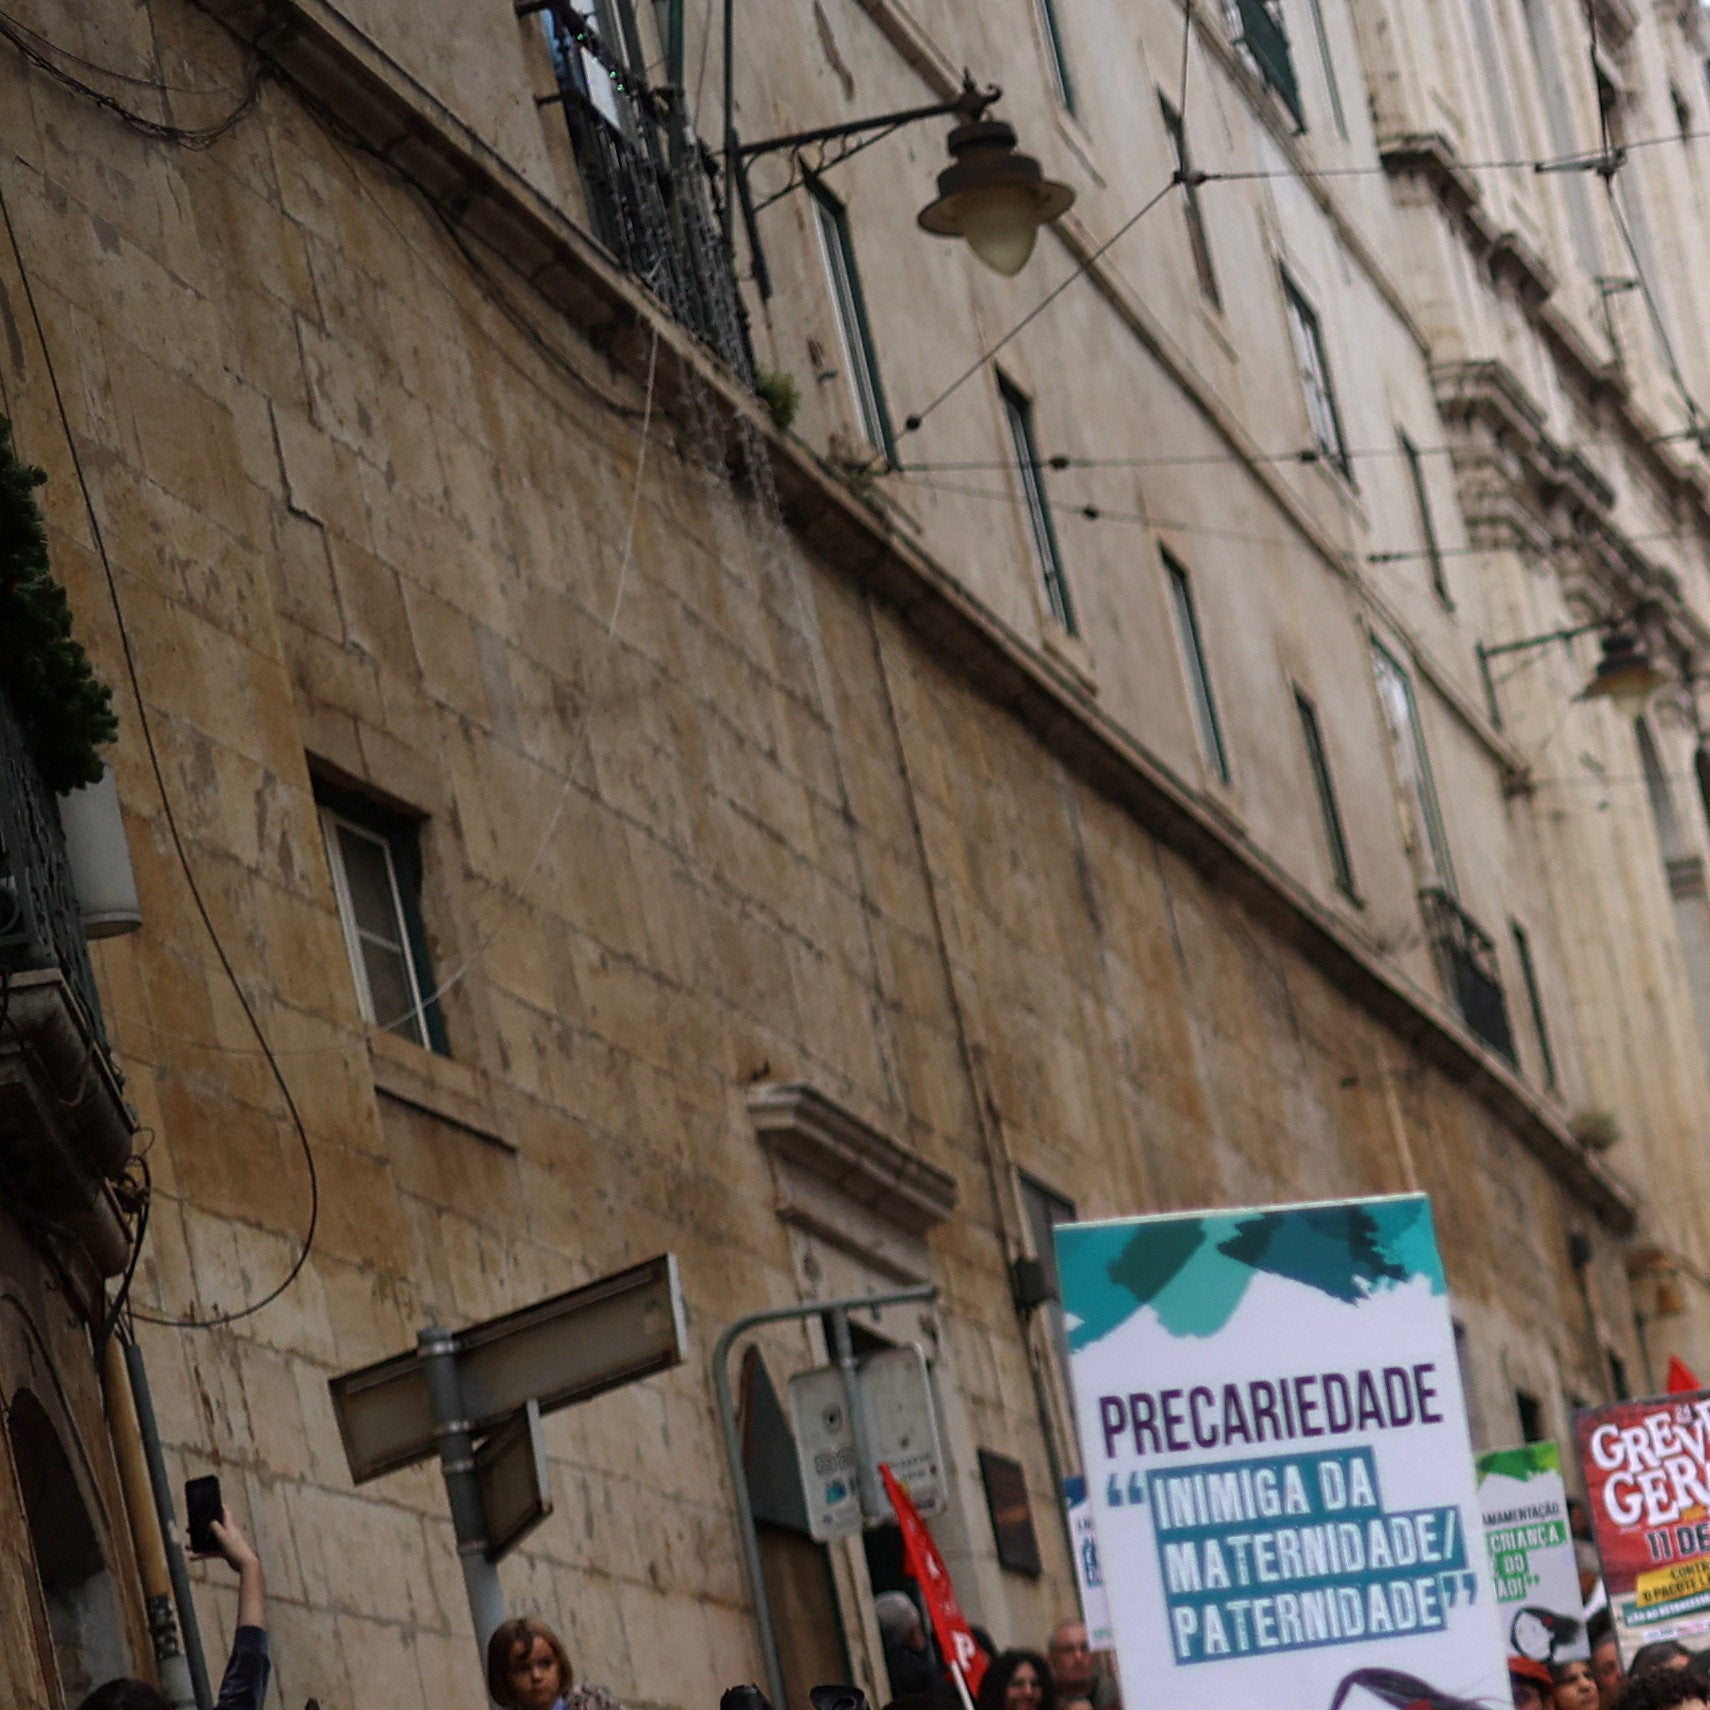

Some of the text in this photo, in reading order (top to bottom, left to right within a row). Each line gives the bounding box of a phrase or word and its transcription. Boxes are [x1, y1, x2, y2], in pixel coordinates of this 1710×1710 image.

[1099, 1362, 1444, 1459] PRECARIEDADE
[1320, 1460, 1377, 1511] DA
[1164, 1511, 1459, 1593] MATERNIDADE/
[1647, 1529, 1673, 1561] 11
